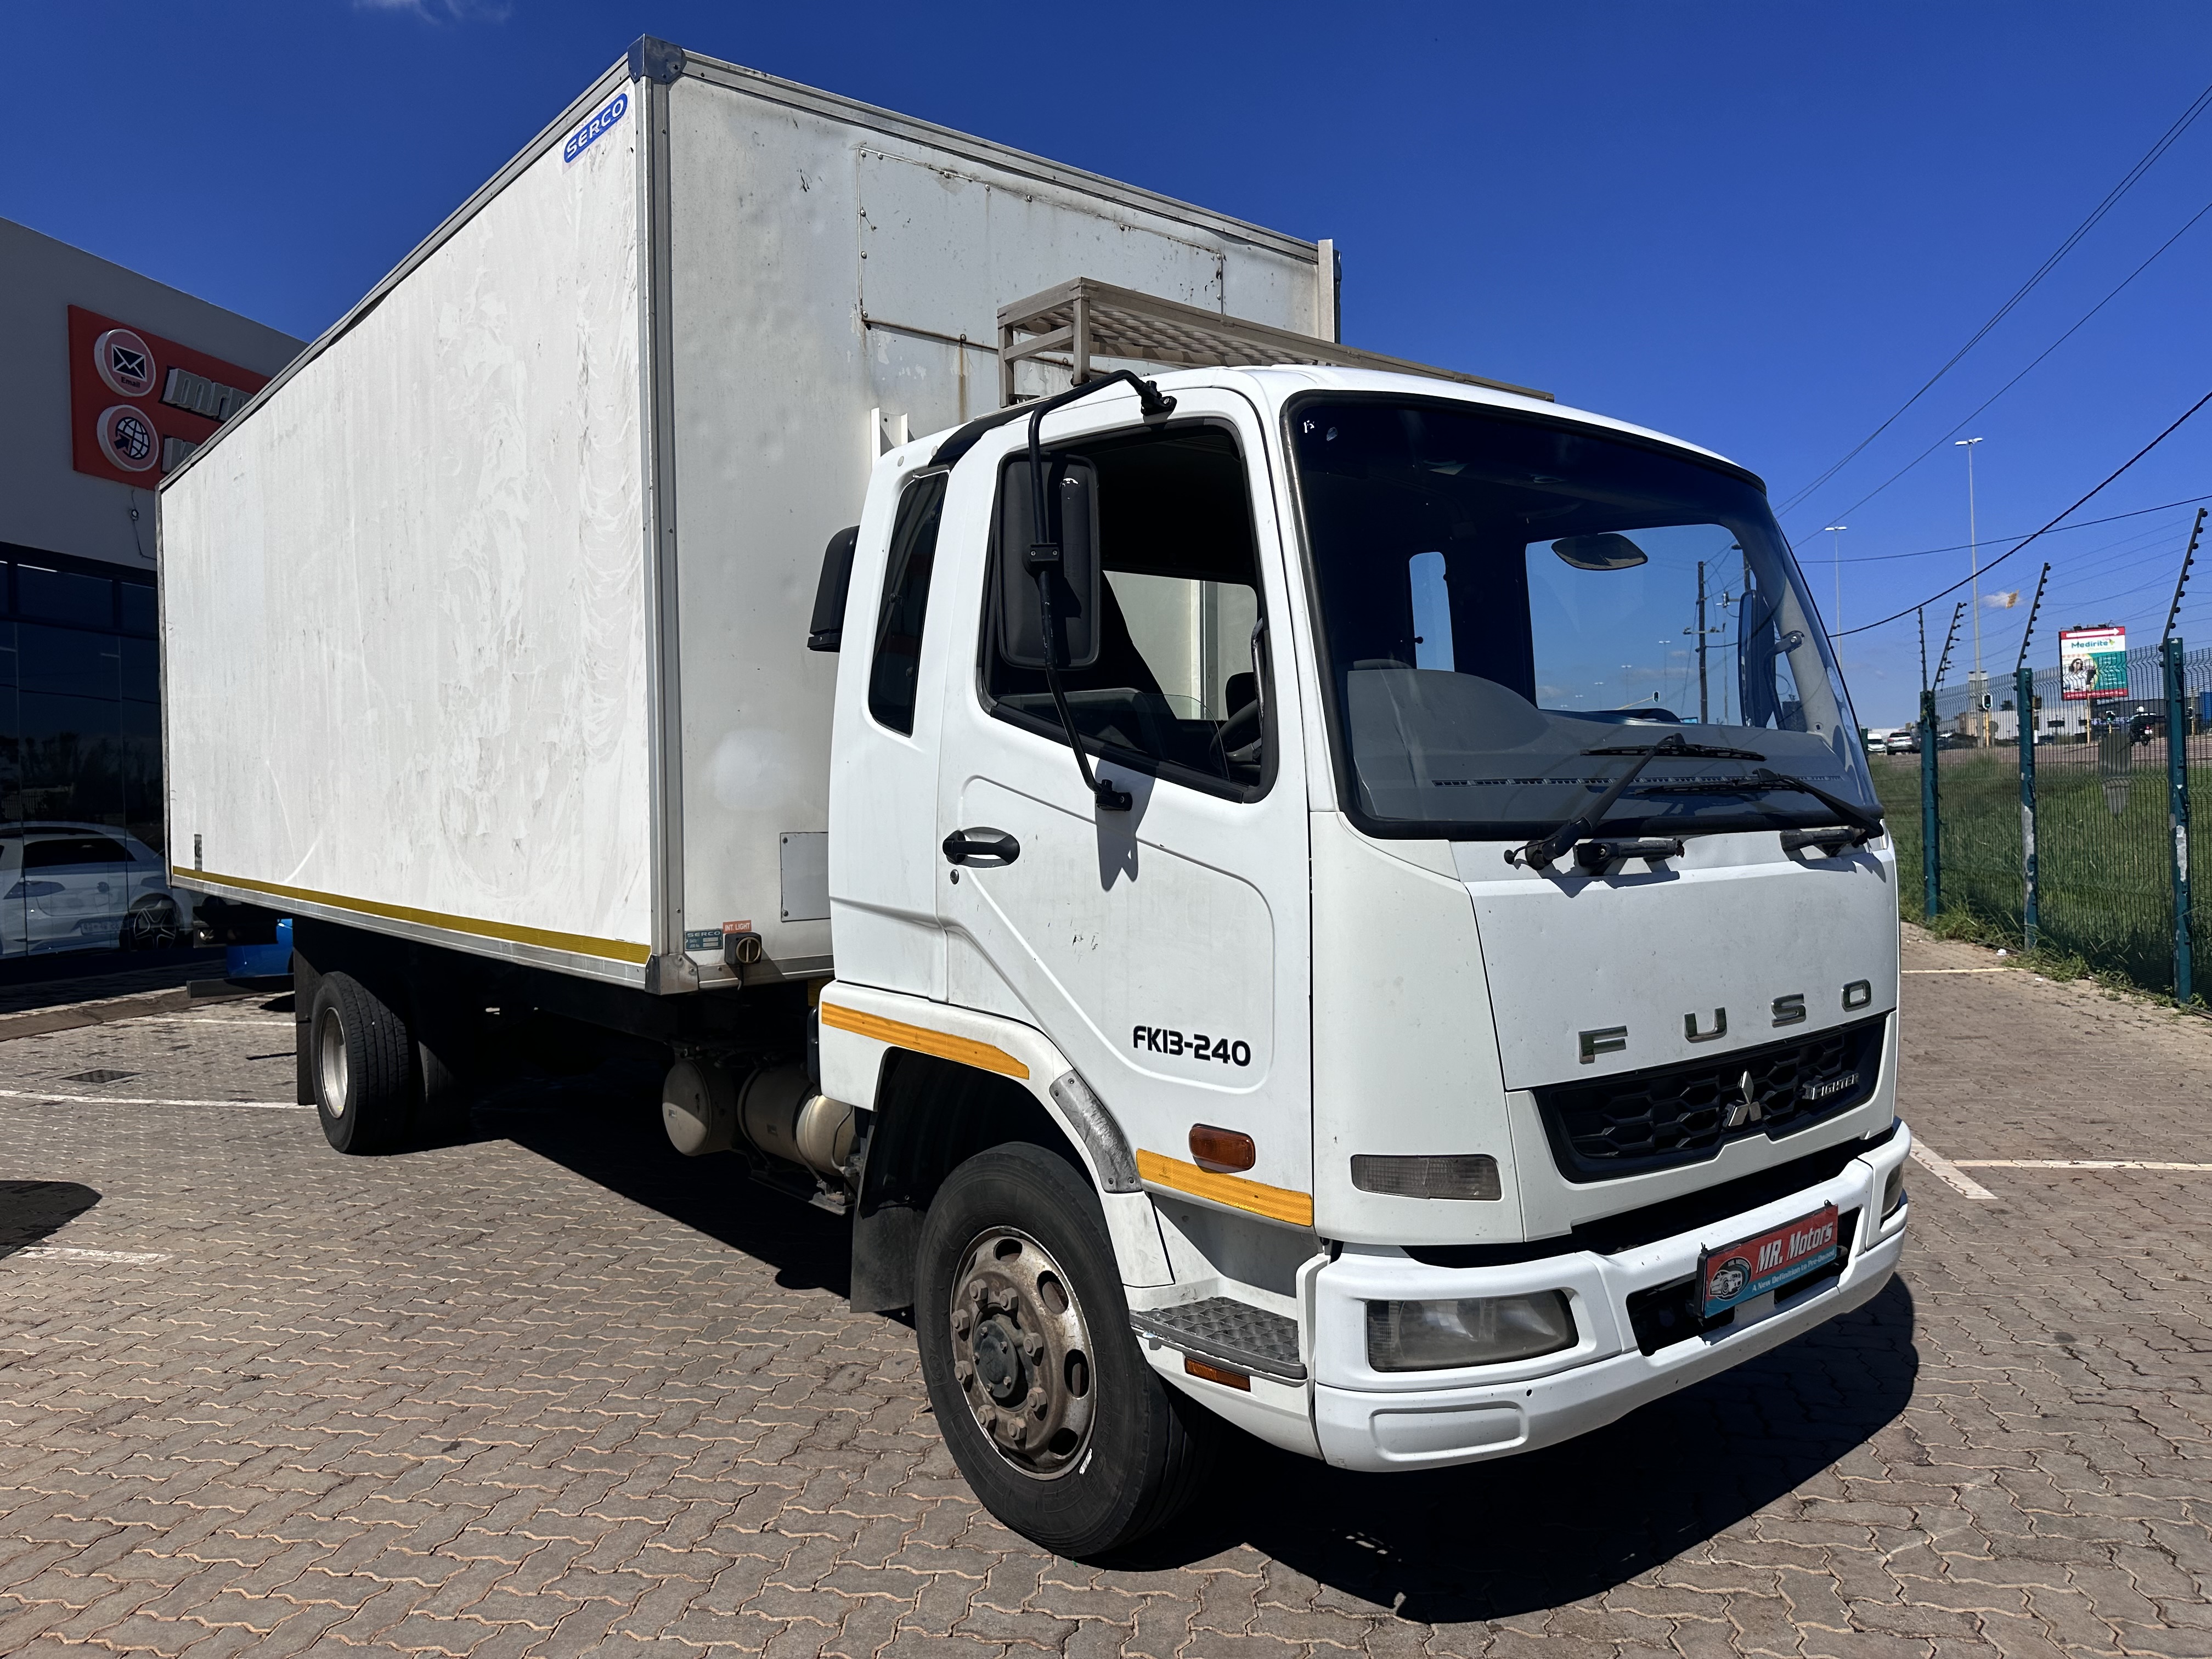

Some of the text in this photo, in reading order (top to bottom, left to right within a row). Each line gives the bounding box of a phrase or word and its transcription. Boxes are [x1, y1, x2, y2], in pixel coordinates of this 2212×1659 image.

[567, 99, 624, 159] SERCO
[121, 376, 141, 388] Email
[2071, 640, 2108, 649] Medirite
[735, 922, 750, 930] LIGHT
[1578, 979, 1871, 1064] FUSO
[1133, 1025, 1251, 1067] FK13-240
[1811, 1073, 1859, 1100] FIGHTER
[1756, 1222, 1834, 1274] MR. Motors
[1752, 1284, 1757, 1293] A
[1758, 1280, 1770, 1290] New
[1772, 1267, 1801, 1284] Definition
[1808, 1248, 1835, 1267] Pre-Owned
